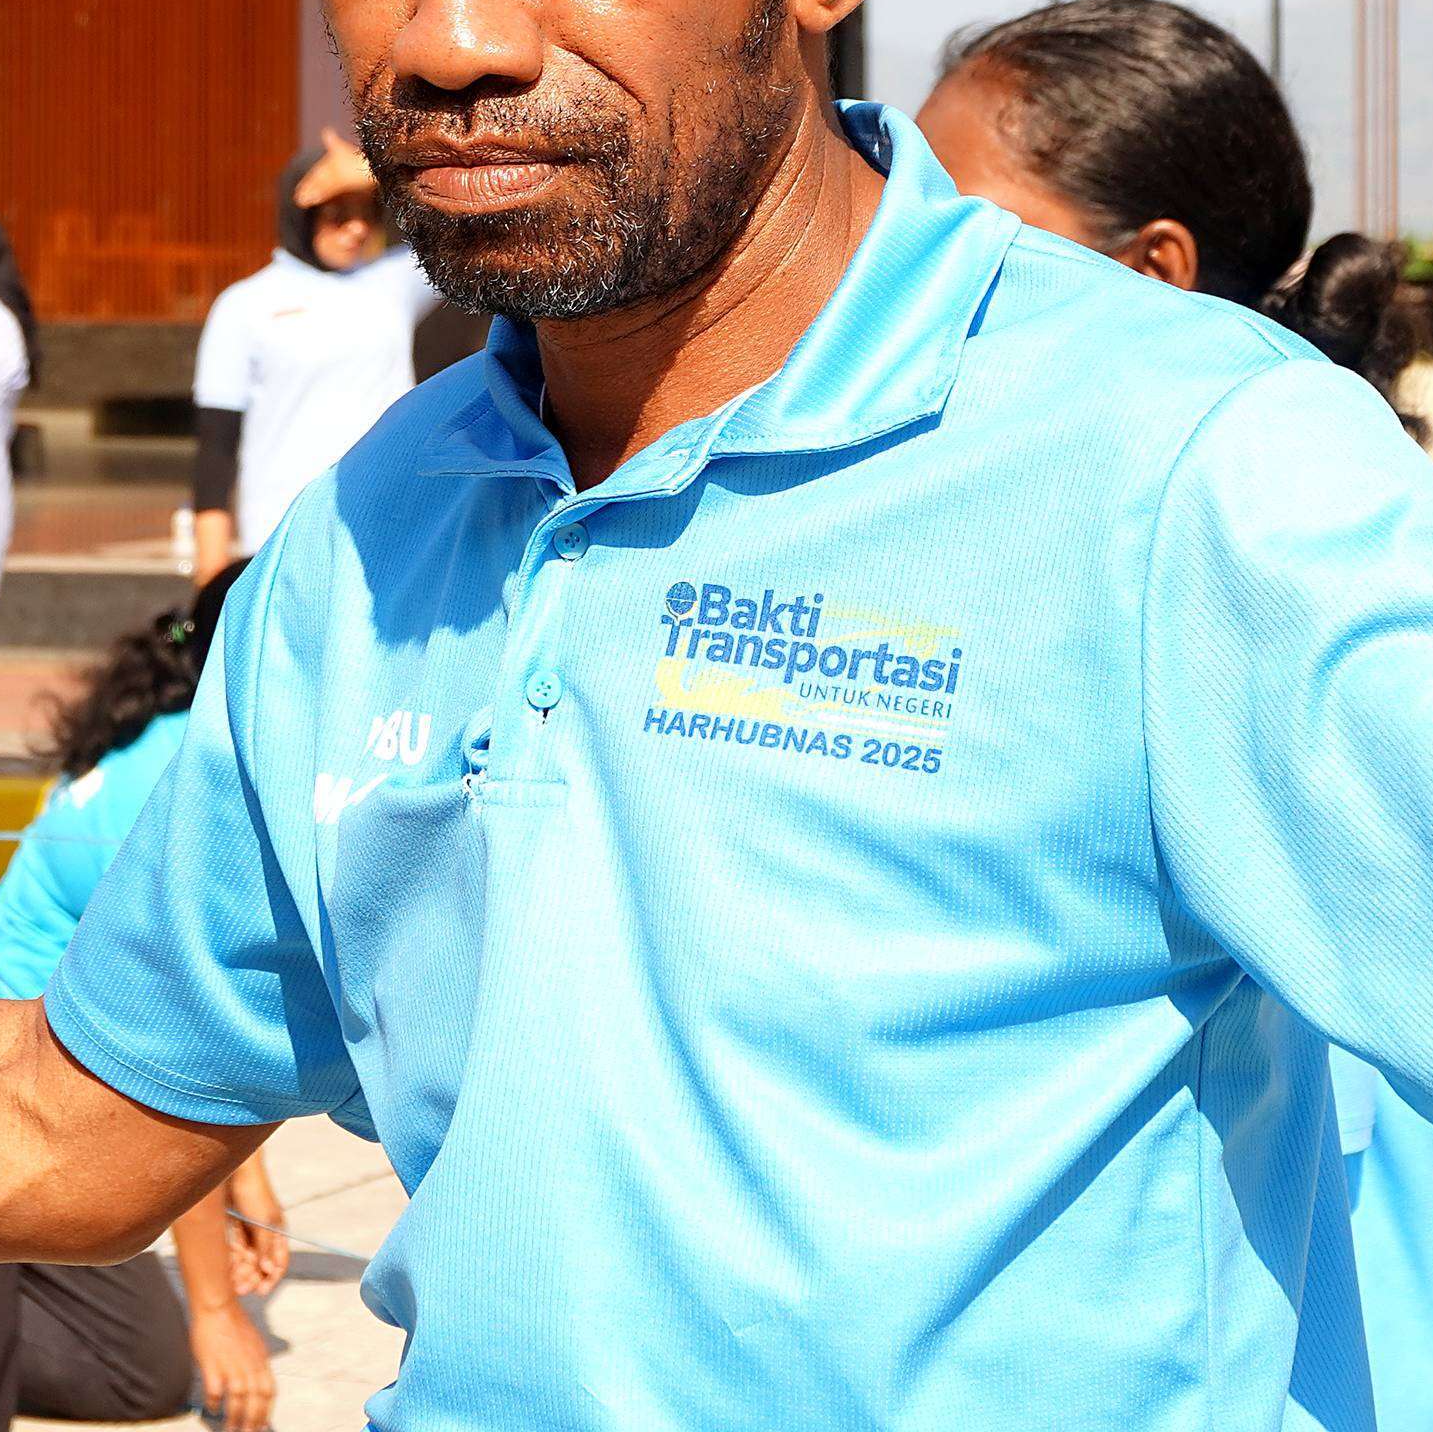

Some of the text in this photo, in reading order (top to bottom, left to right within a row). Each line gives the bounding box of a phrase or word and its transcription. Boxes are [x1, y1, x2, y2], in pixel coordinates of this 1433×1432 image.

[697, 582, 825, 638] Bakti
[660, 613, 964, 695] Transportasi
[799, 682, 954, 720] UNTUK NEGERI
[643, 707, 944, 775] HARHUBNAS 2025
